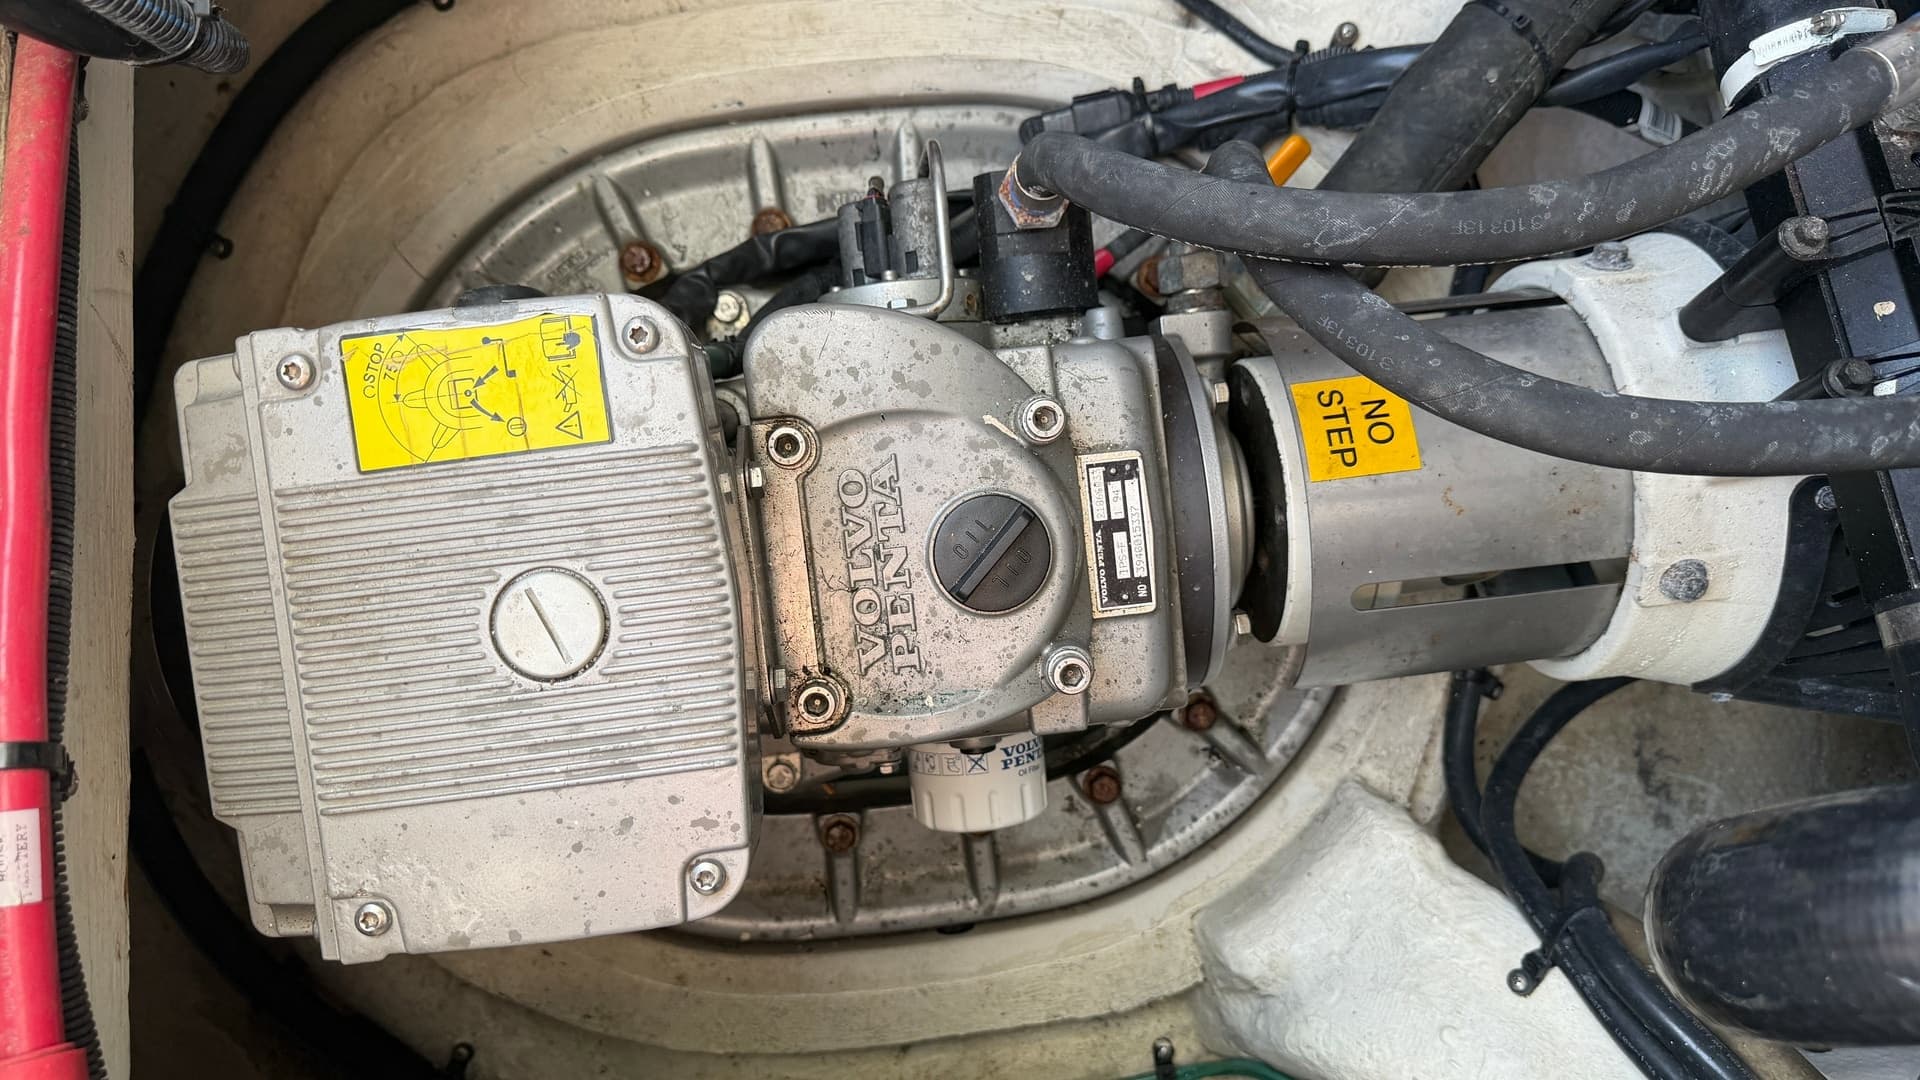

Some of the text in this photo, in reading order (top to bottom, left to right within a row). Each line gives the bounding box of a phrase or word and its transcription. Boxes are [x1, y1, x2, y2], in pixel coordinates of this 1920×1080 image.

[1316, 389, 1358, 468] STEP
[1360, 399, 1395, 445] NO
[952, 519, 993, 560] OIL
[837, 468, 887, 676] VOLVO
[870, 452, 922, 675] PENTA
[991, 547, 1032, 591] OIL
[1095, 528, 1109, 604] VOLVO PENTA
[1137, 583, 1148, 598] NO
[1000, 738, 1040, 756] VOLV
[1000, 749, 1042, 770] PENT
